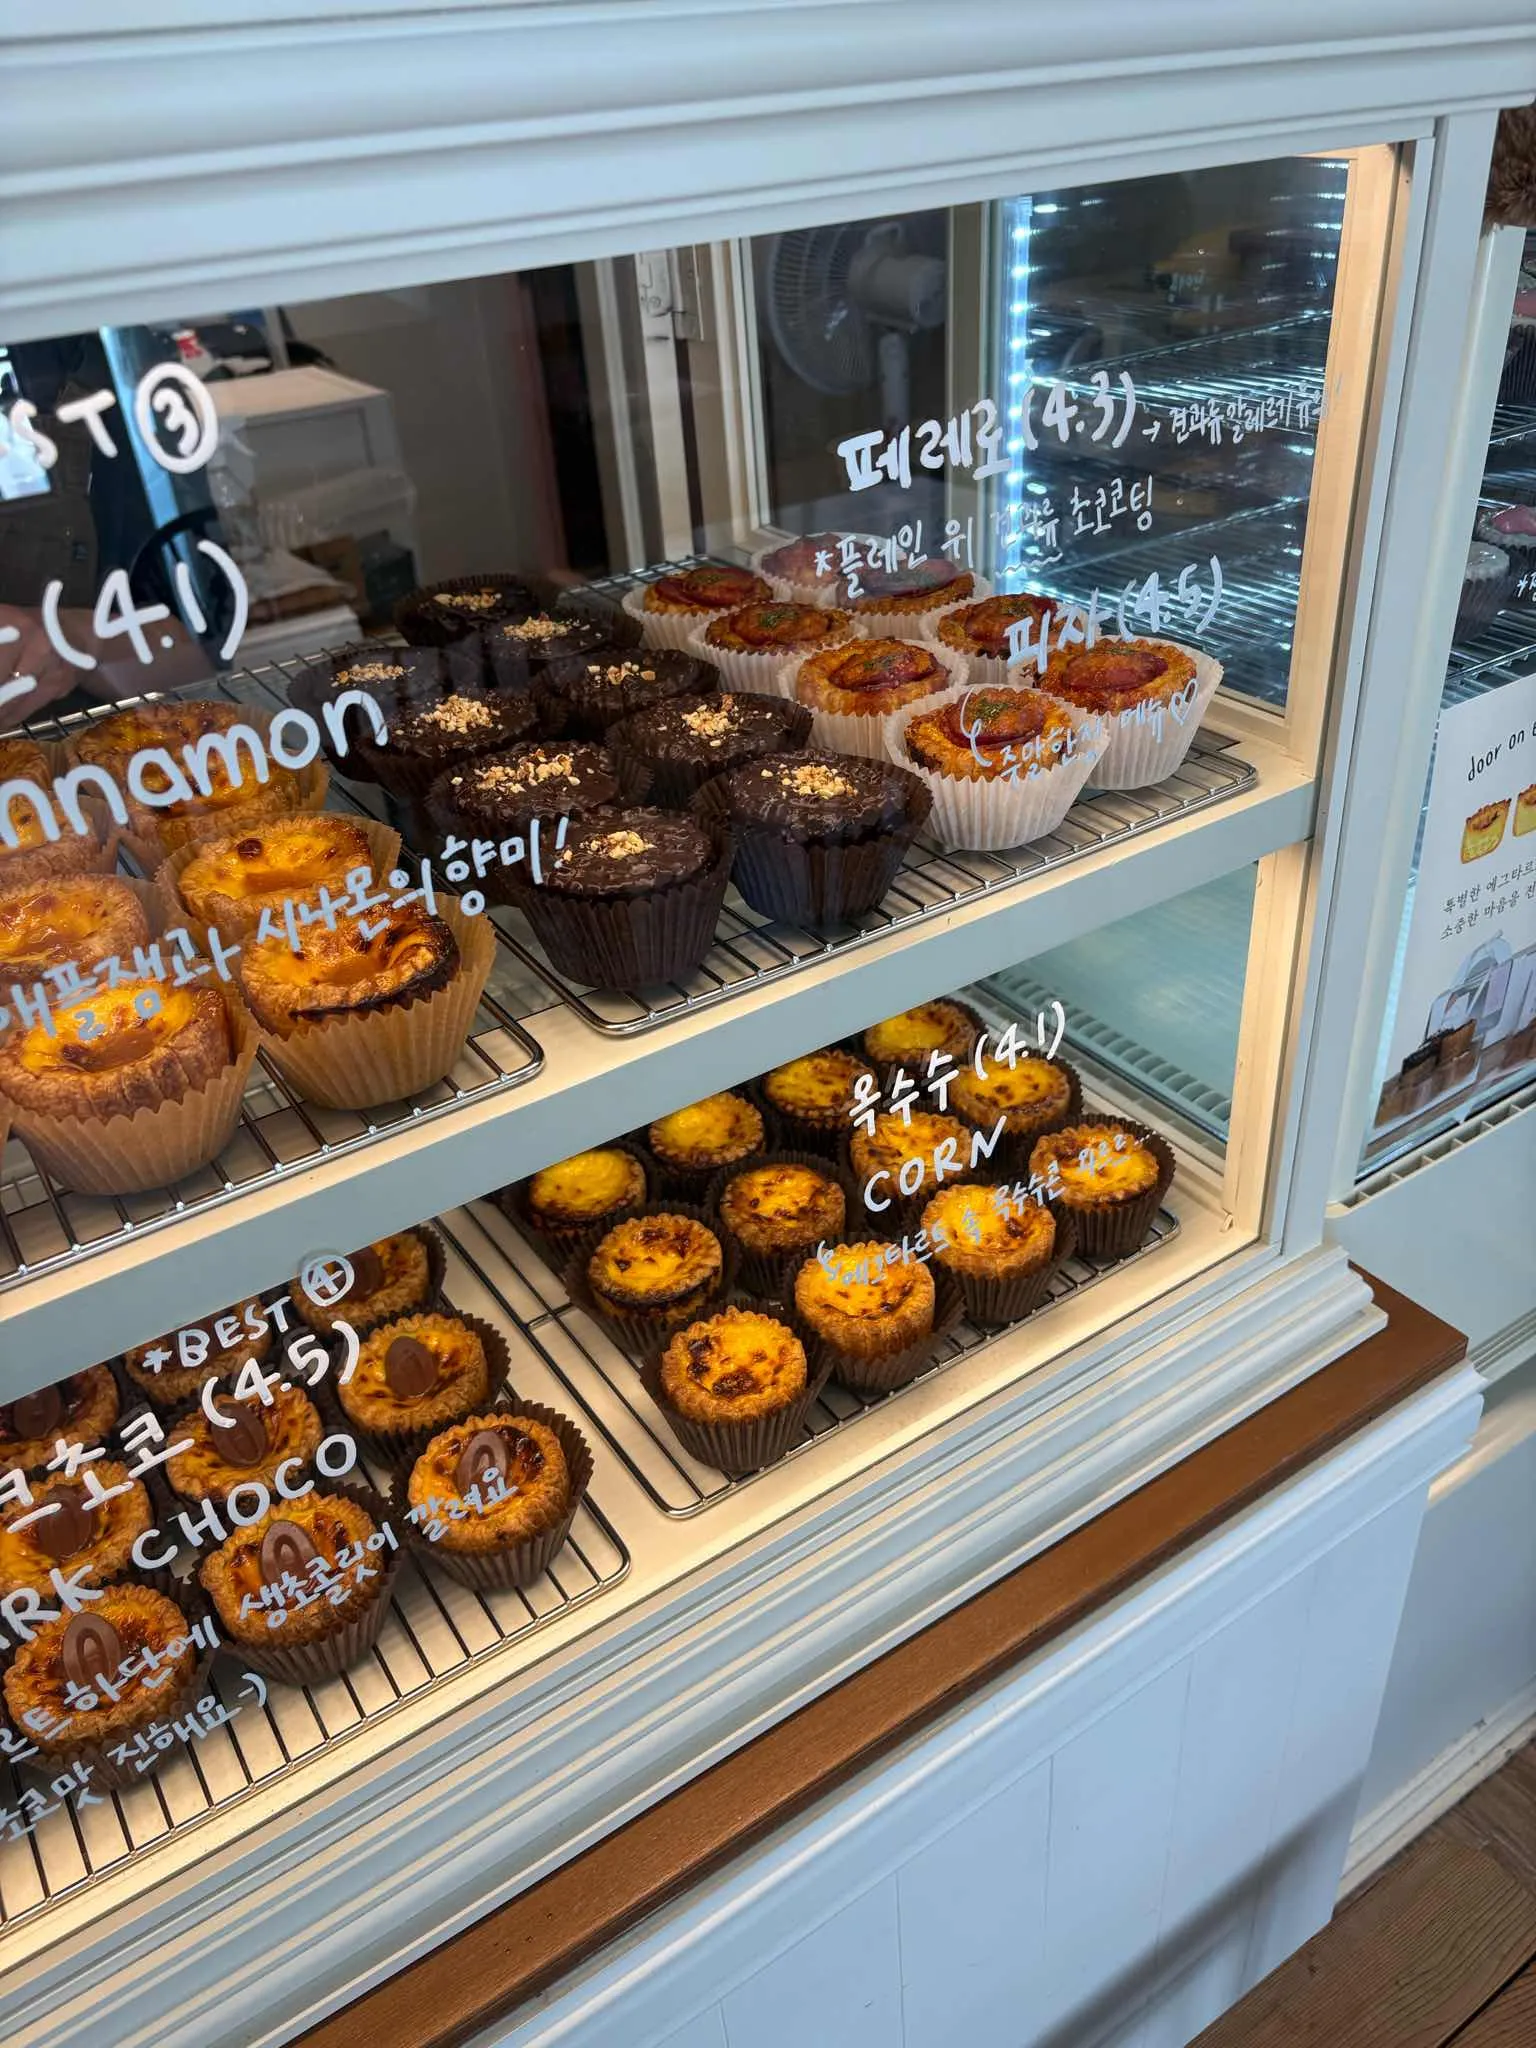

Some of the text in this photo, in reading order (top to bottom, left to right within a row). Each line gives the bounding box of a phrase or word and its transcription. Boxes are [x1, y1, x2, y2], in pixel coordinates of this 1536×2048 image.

[0, 388, 118, 469] ST
[838, 371, 1137, 492] 페레로 (4.3)
[835, 519, 928, 599] 플레인
[941, 516, 974, 569] 위
[1070, 474, 1154, 536] 초코코팅
[42, 540, 249, 671] (4.1)
[1004, 554, 1223, 673] 피자 (4.5)
[1468, 730, 1525, 781] door on
[1440, 908, 1480, 941] 소중한
[1484, 890, 1521, 918] 마음을
[1443, 883, 1481, 914] 특별한
[849, 1001, 1066, 1136] 옥수수 (4.1)
[863, 1115, 1007, 1212] CORN
[201, 1320, 361, 1429] (4.5)
[0, 1433, 358, 1650] RK CHOCO
